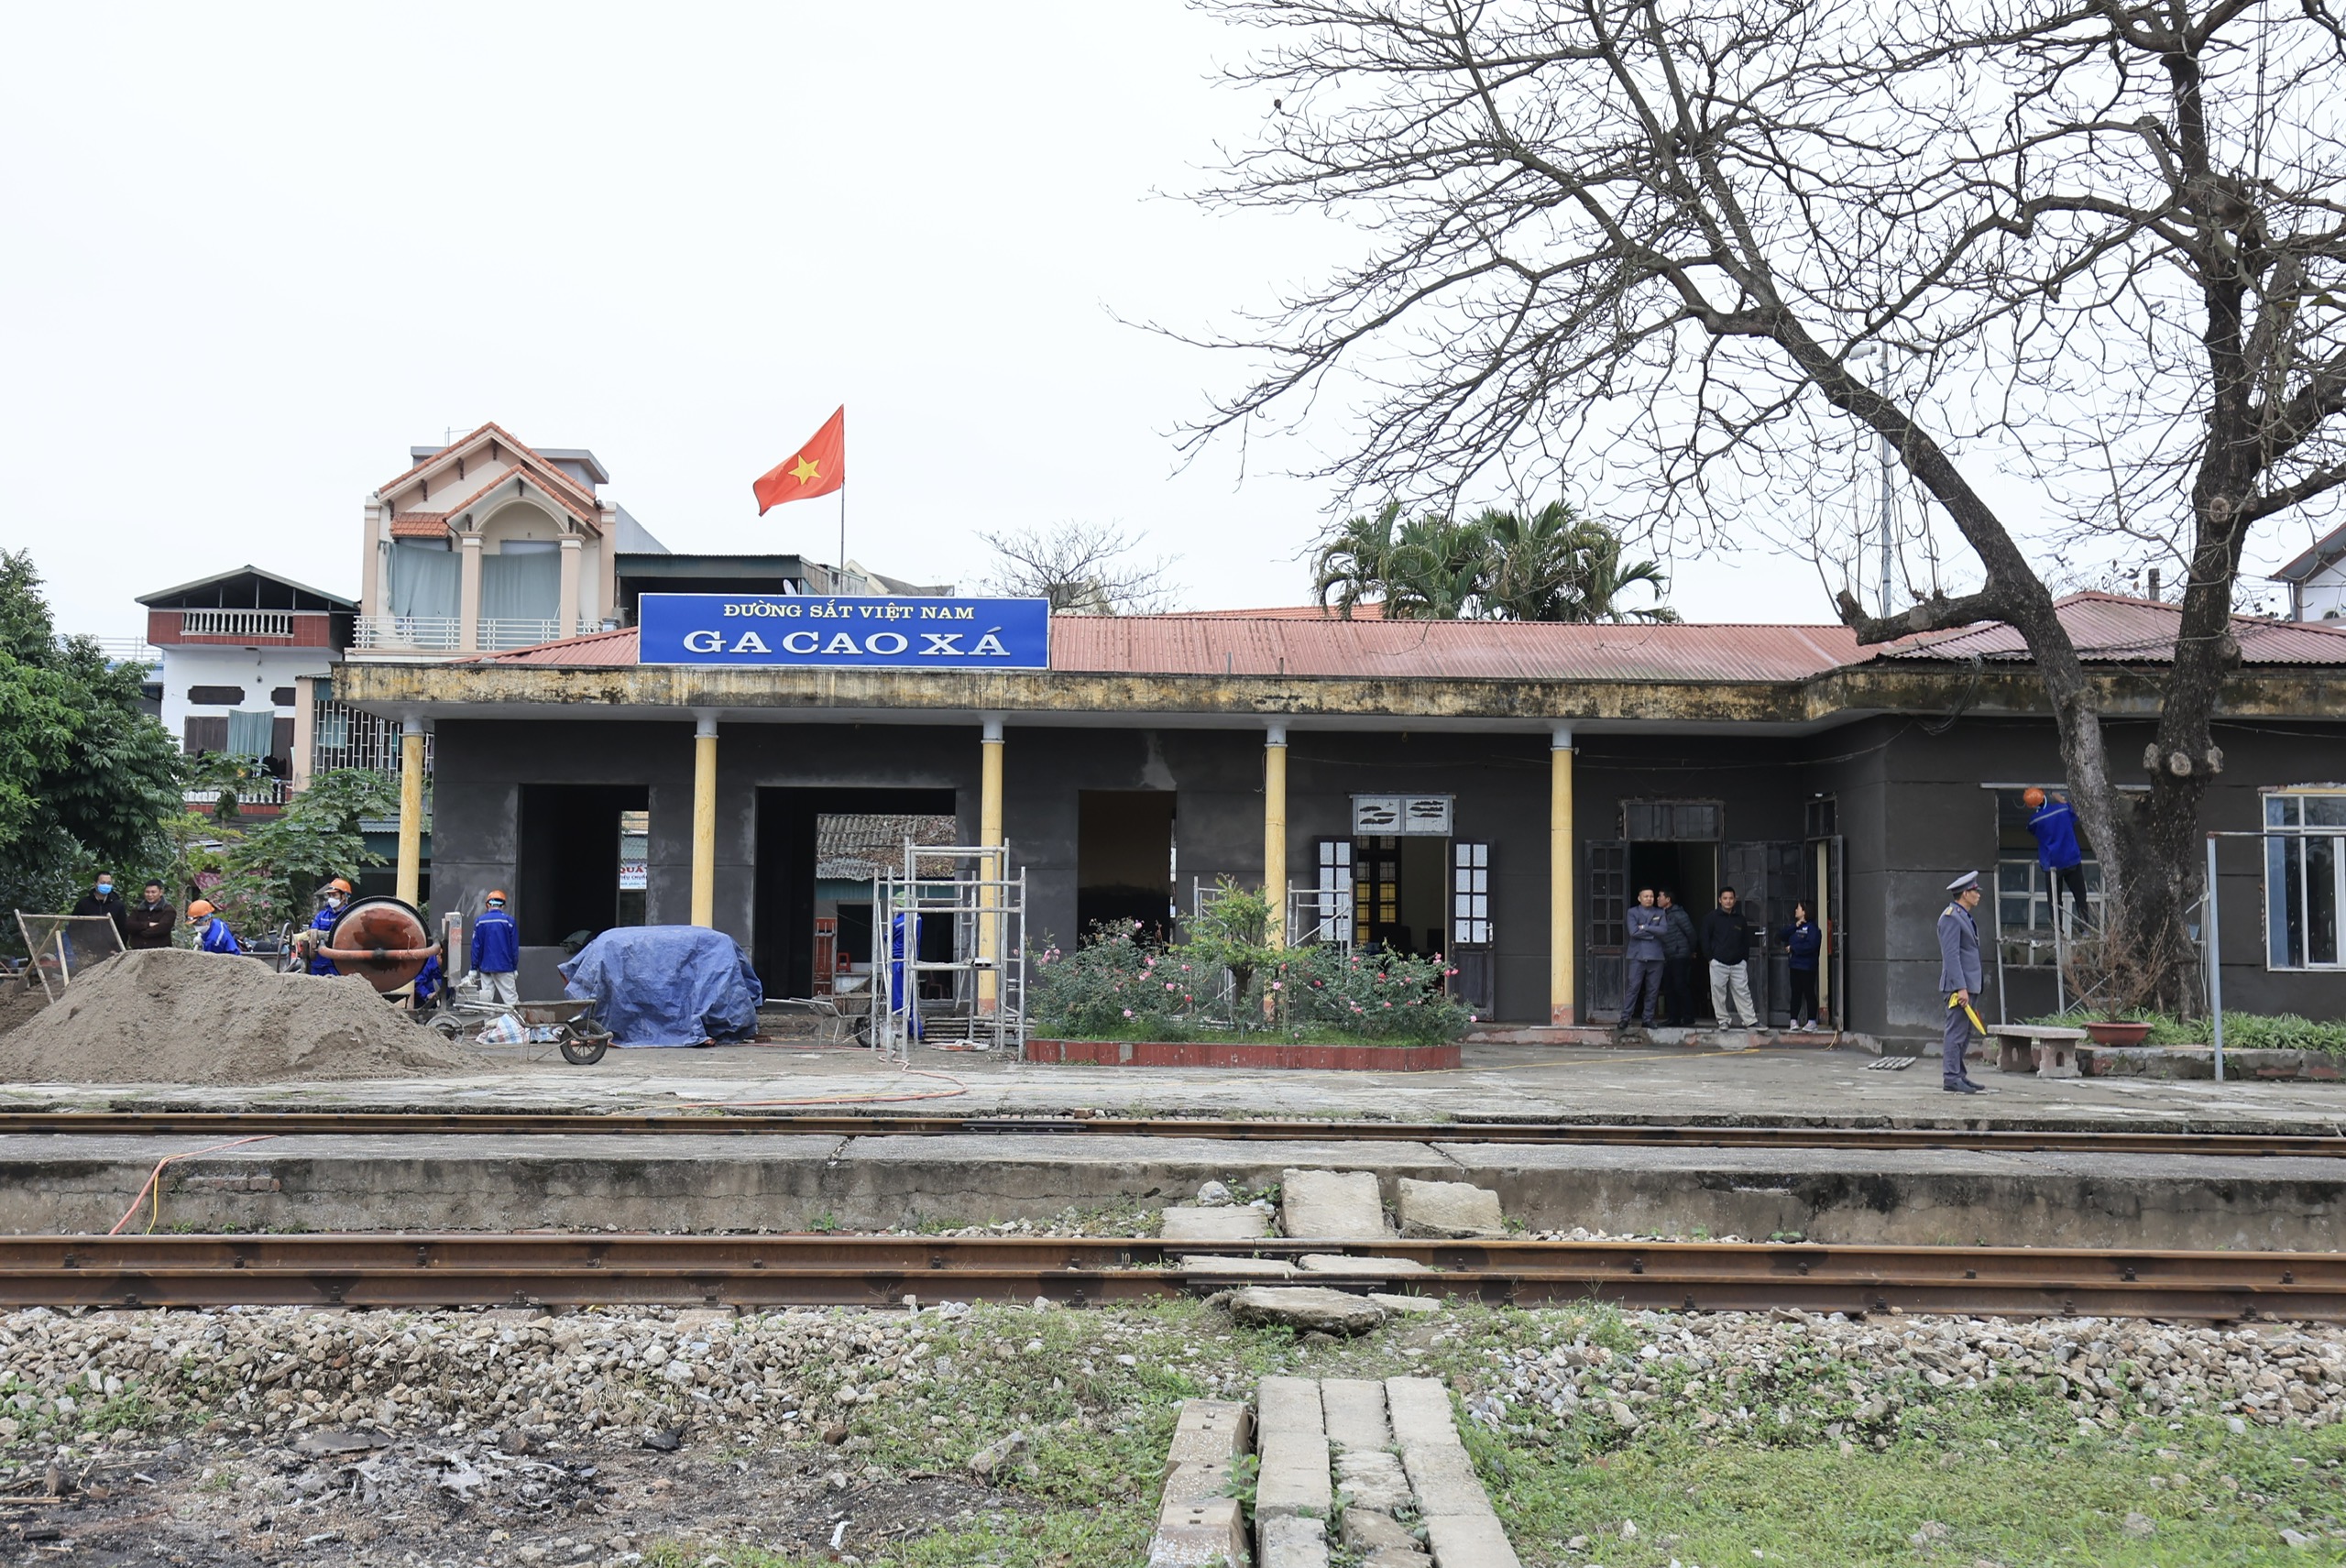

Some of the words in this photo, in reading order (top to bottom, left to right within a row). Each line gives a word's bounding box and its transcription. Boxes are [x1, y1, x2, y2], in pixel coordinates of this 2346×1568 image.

[723, 599, 803, 618] ĐƯỜNG
[809, 598, 853, 619] SẮT
[858, 601, 914, 622] VIỆT
[920, 607, 975, 620] NAM
[683, 630, 773, 653] GA
[782, 630, 909, 655] CAO
[918, 626, 1011, 656] XÁ
[1121, 1252, 1131, 1265] 10
